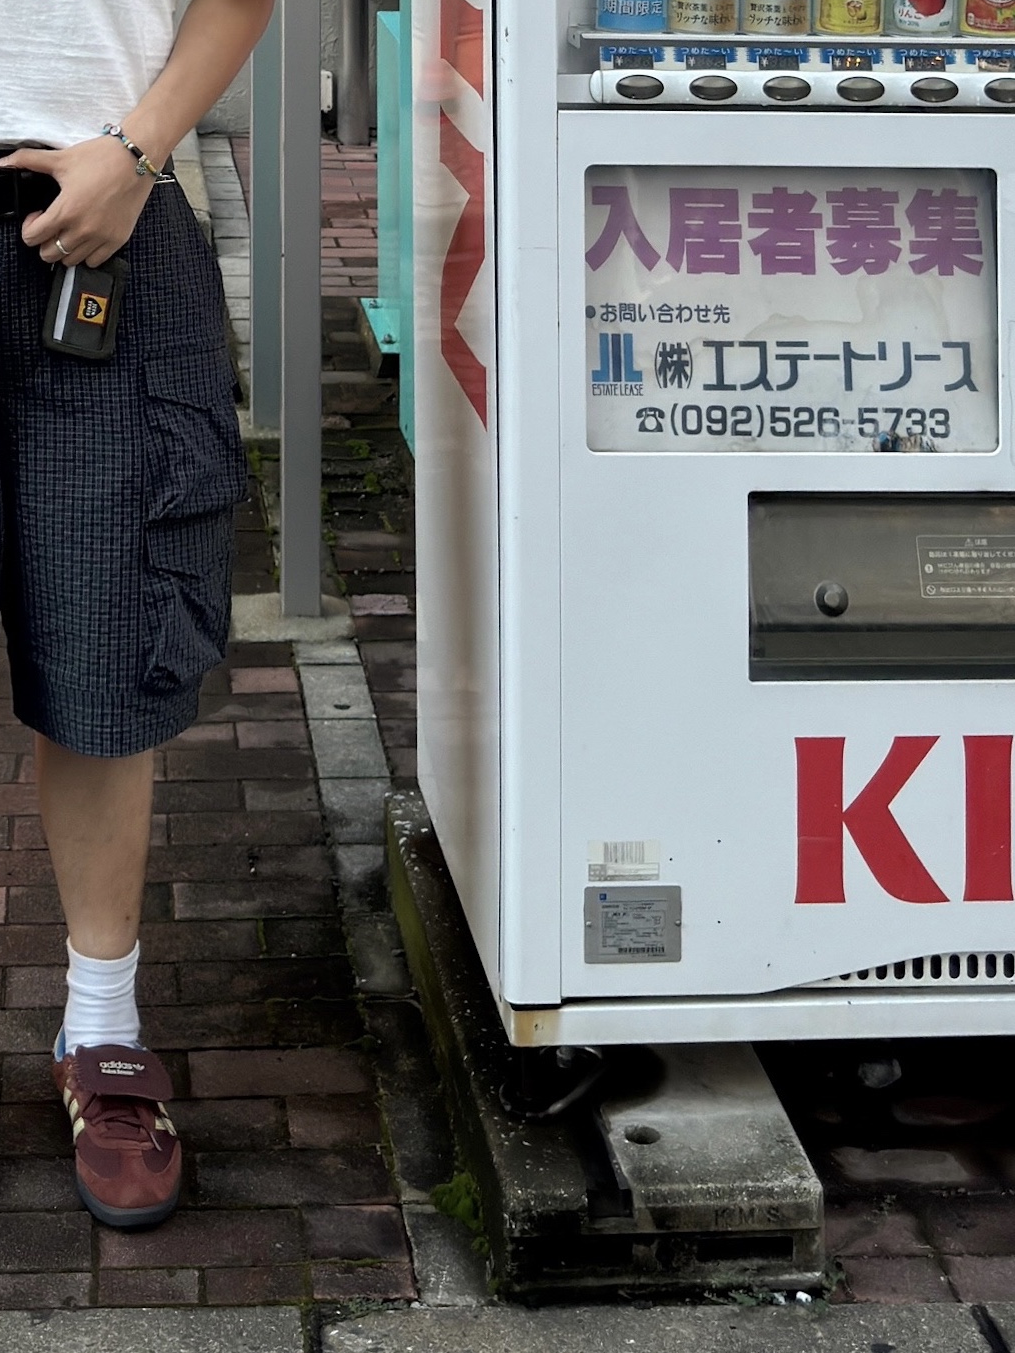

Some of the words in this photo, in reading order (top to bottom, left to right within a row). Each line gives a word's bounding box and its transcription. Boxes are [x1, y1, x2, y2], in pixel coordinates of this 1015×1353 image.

[585, 186, 984, 276] 入居者募集
[600, 303, 731, 324] お問い合わせ先
[592, 383, 618, 397] ESTATE
[619, 383, 644, 396] LEASE
[670, 403, 951, 440] (092)526-5733
[794, 735, 1014, 904] KI
[99, 1060, 133, 1070] adidas
